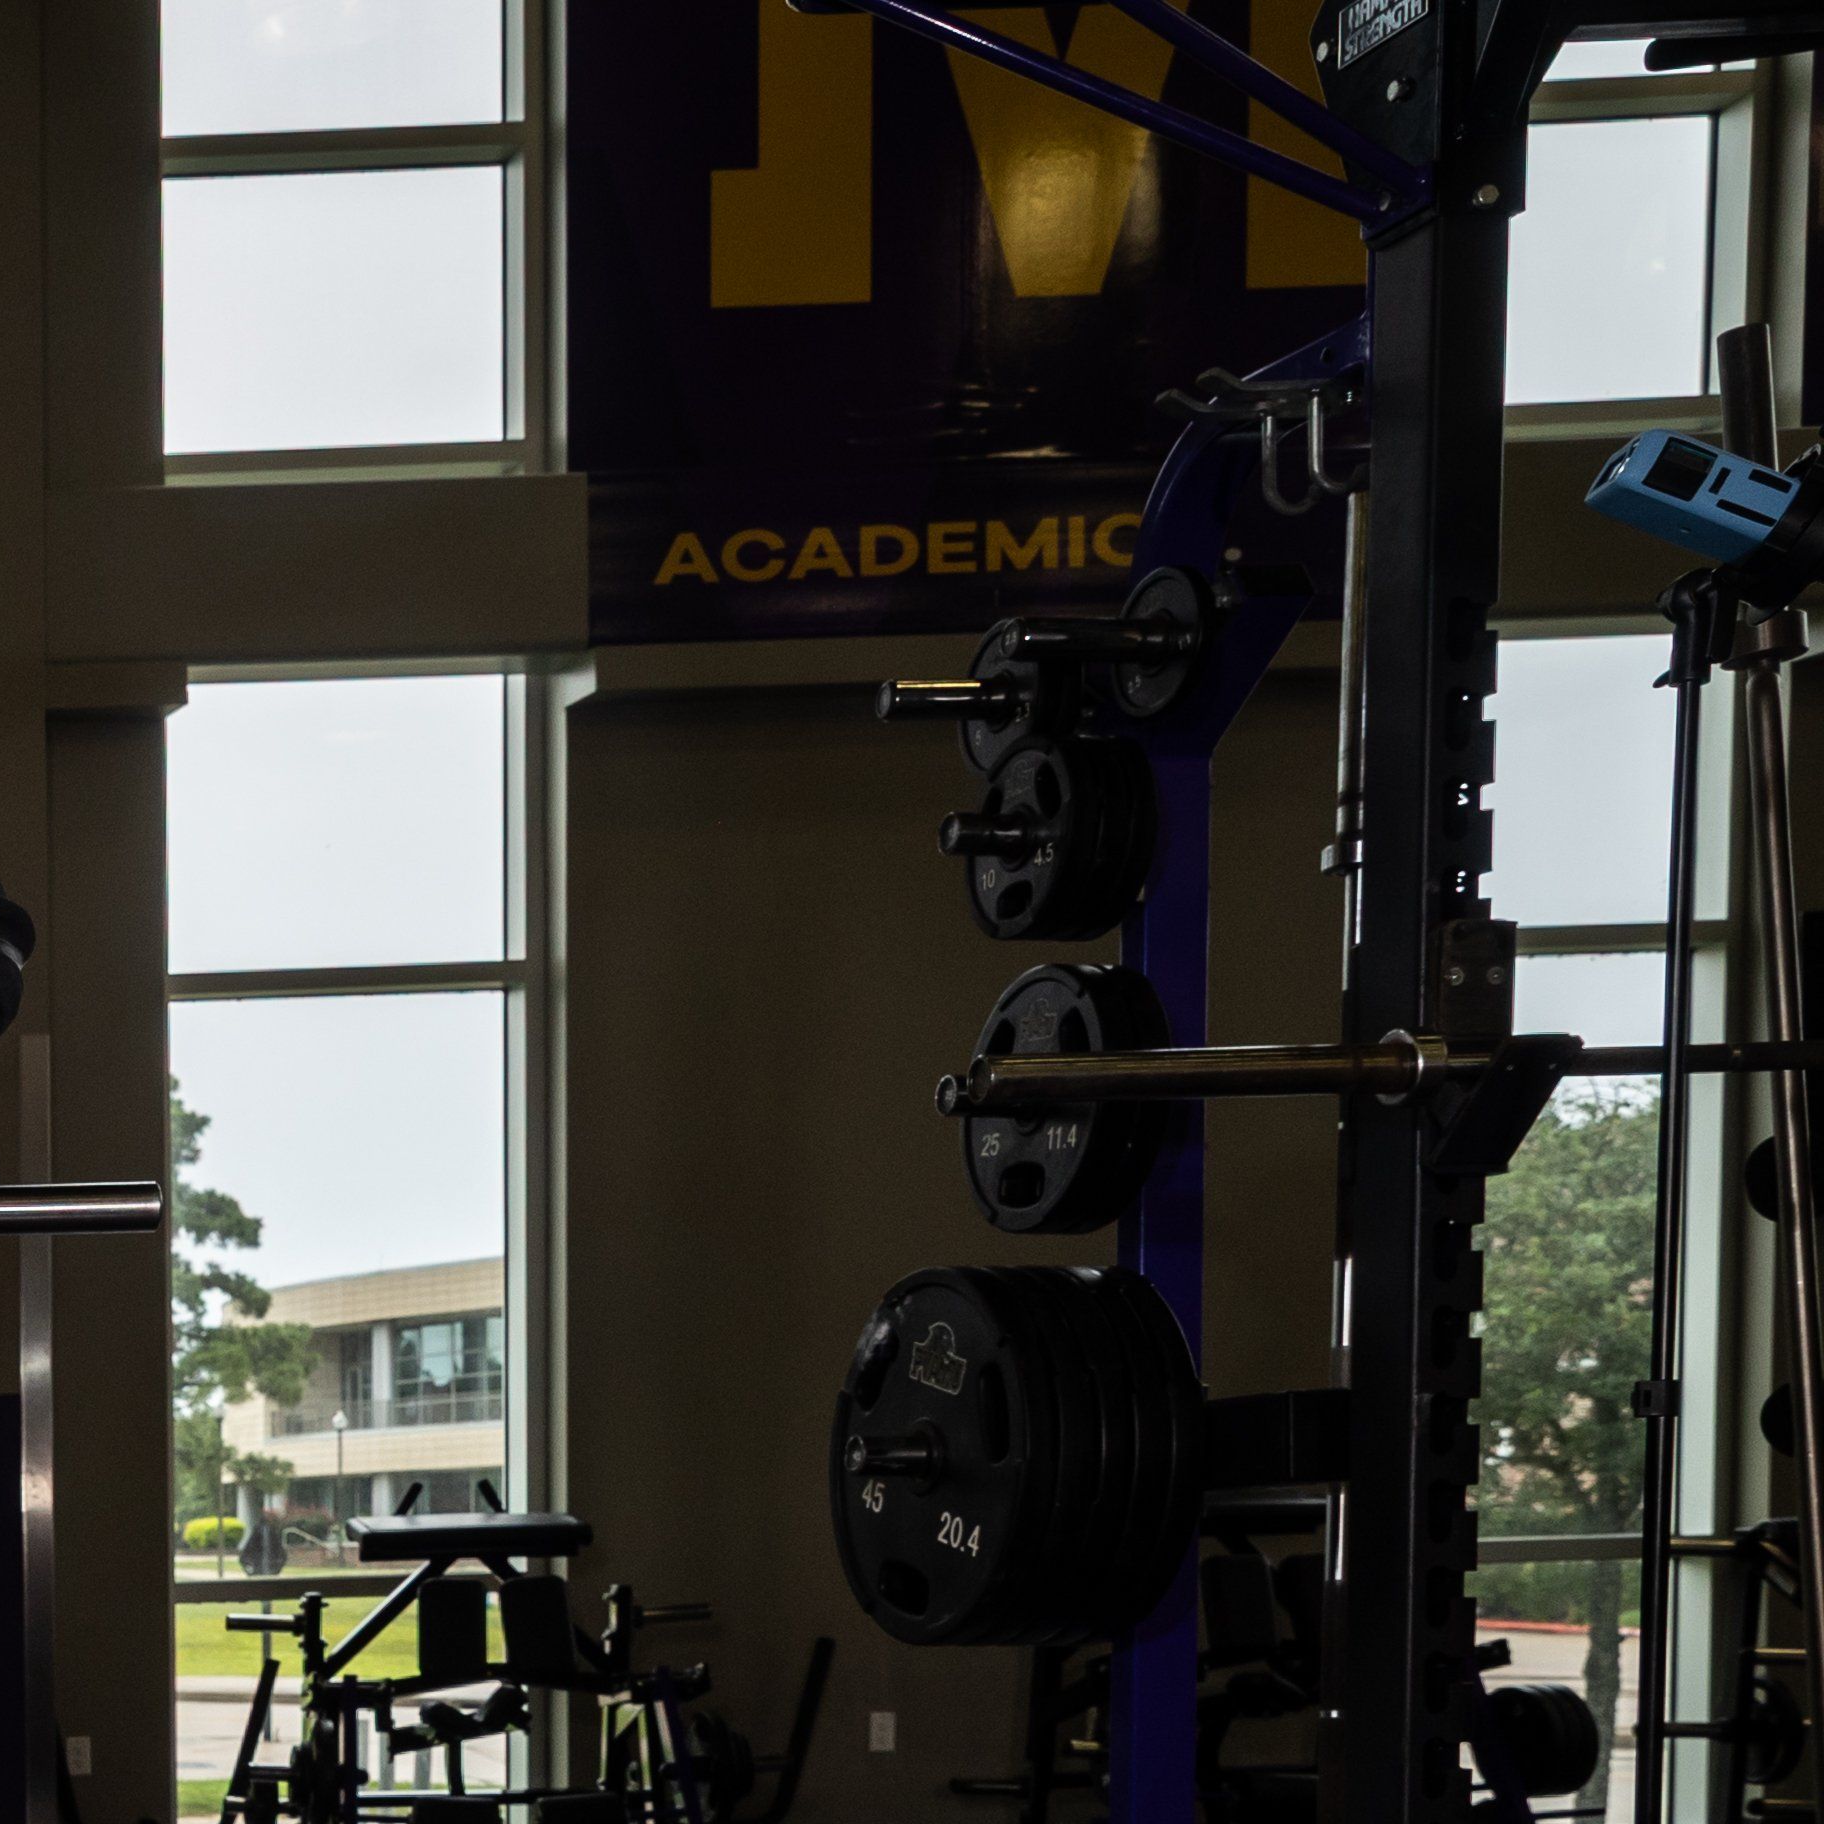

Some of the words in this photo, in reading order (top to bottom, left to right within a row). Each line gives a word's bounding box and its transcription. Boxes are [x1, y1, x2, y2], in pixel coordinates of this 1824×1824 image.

[1033, 842, 1054, 867] 4.5
[980, 868, 996, 890] 10
[980, 1133, 1000, 1158] 25
[1047, 1124, 1078, 1151] 11.4
[861, 1478, 886, 1514] 45
[936, 1510, 983, 1558] 20.4
